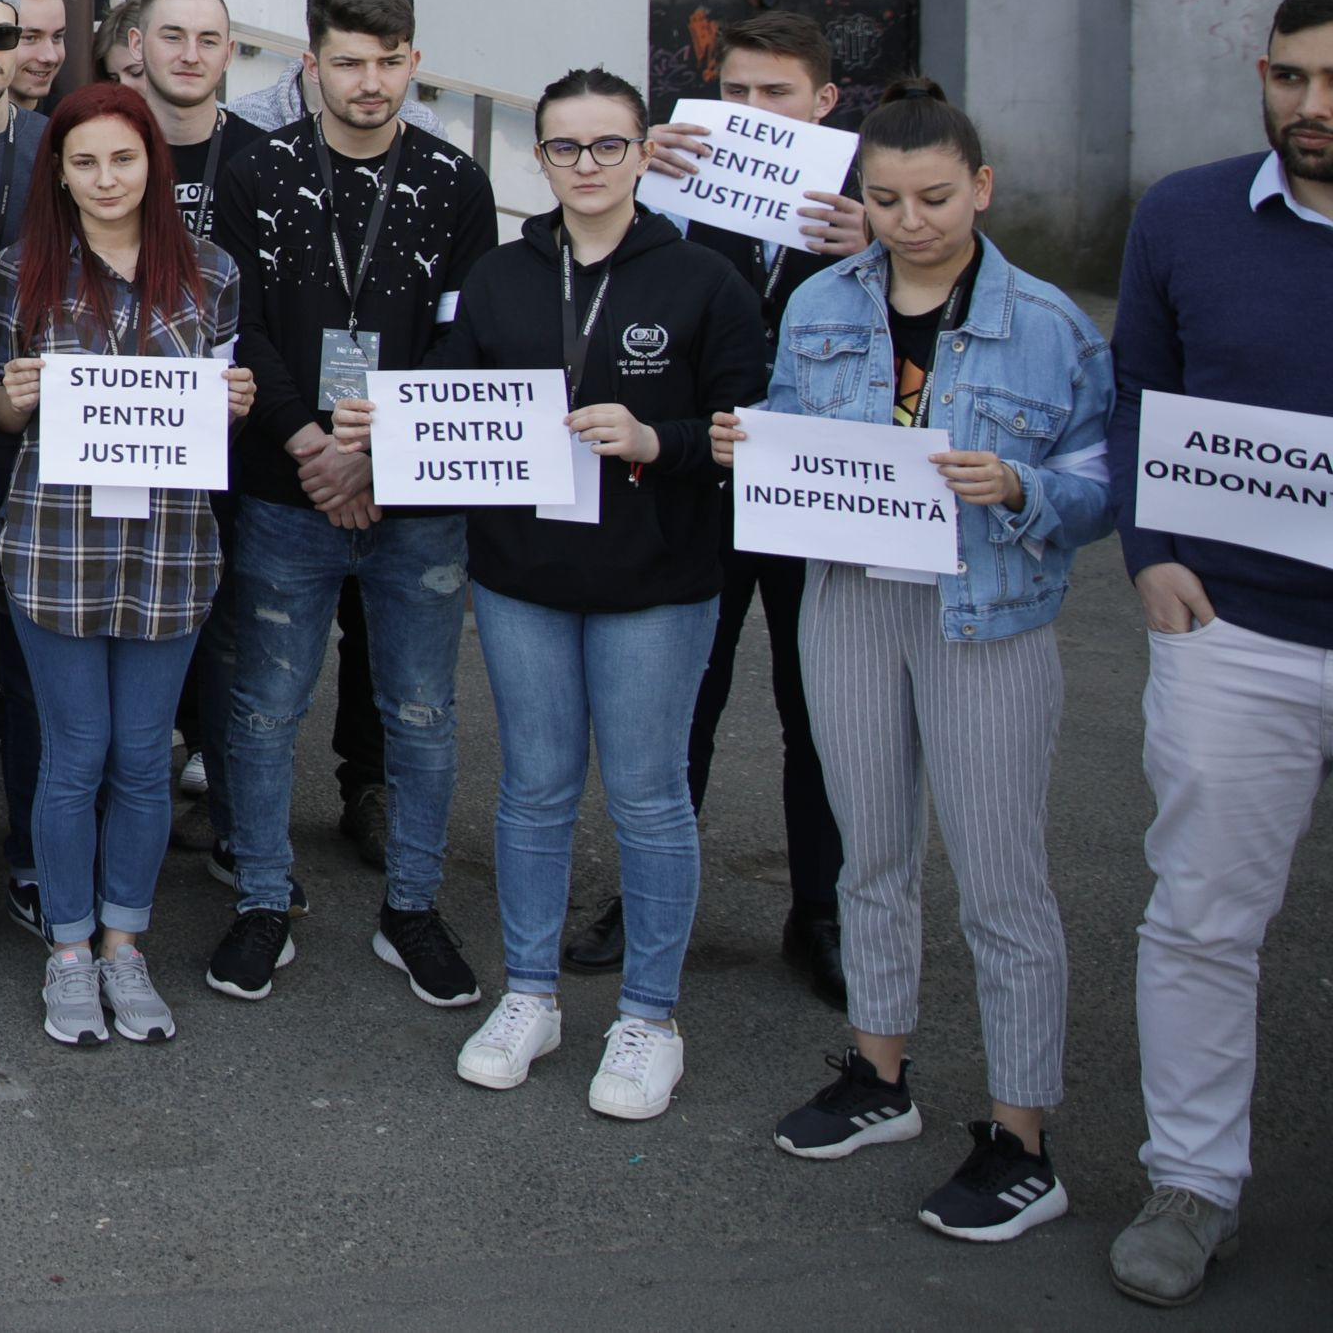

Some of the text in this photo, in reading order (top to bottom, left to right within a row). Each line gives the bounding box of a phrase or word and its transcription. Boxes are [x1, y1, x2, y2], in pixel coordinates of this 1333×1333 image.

[727, 115, 794, 148] ELEVI
[680, 177, 789, 220] JUSTIȚIE
[71, 368, 196, 395] STUDENȚI
[399, 383, 533, 407] STUDENȚI
[84, 406, 184, 427] PENTRU
[416, 421, 522, 441] PENTRU
[80, 443, 186, 469] JUSTIȚIE
[1185, 431, 1333, 475] ABROGA
[415, 461, 529, 486] JUSTIȚIE
[791, 455, 895, 484] JUSTIȚIE
[1145, 460, 1333, 507] ORDONAN
[747, 486, 946, 522] INDEPENDENTĂ
